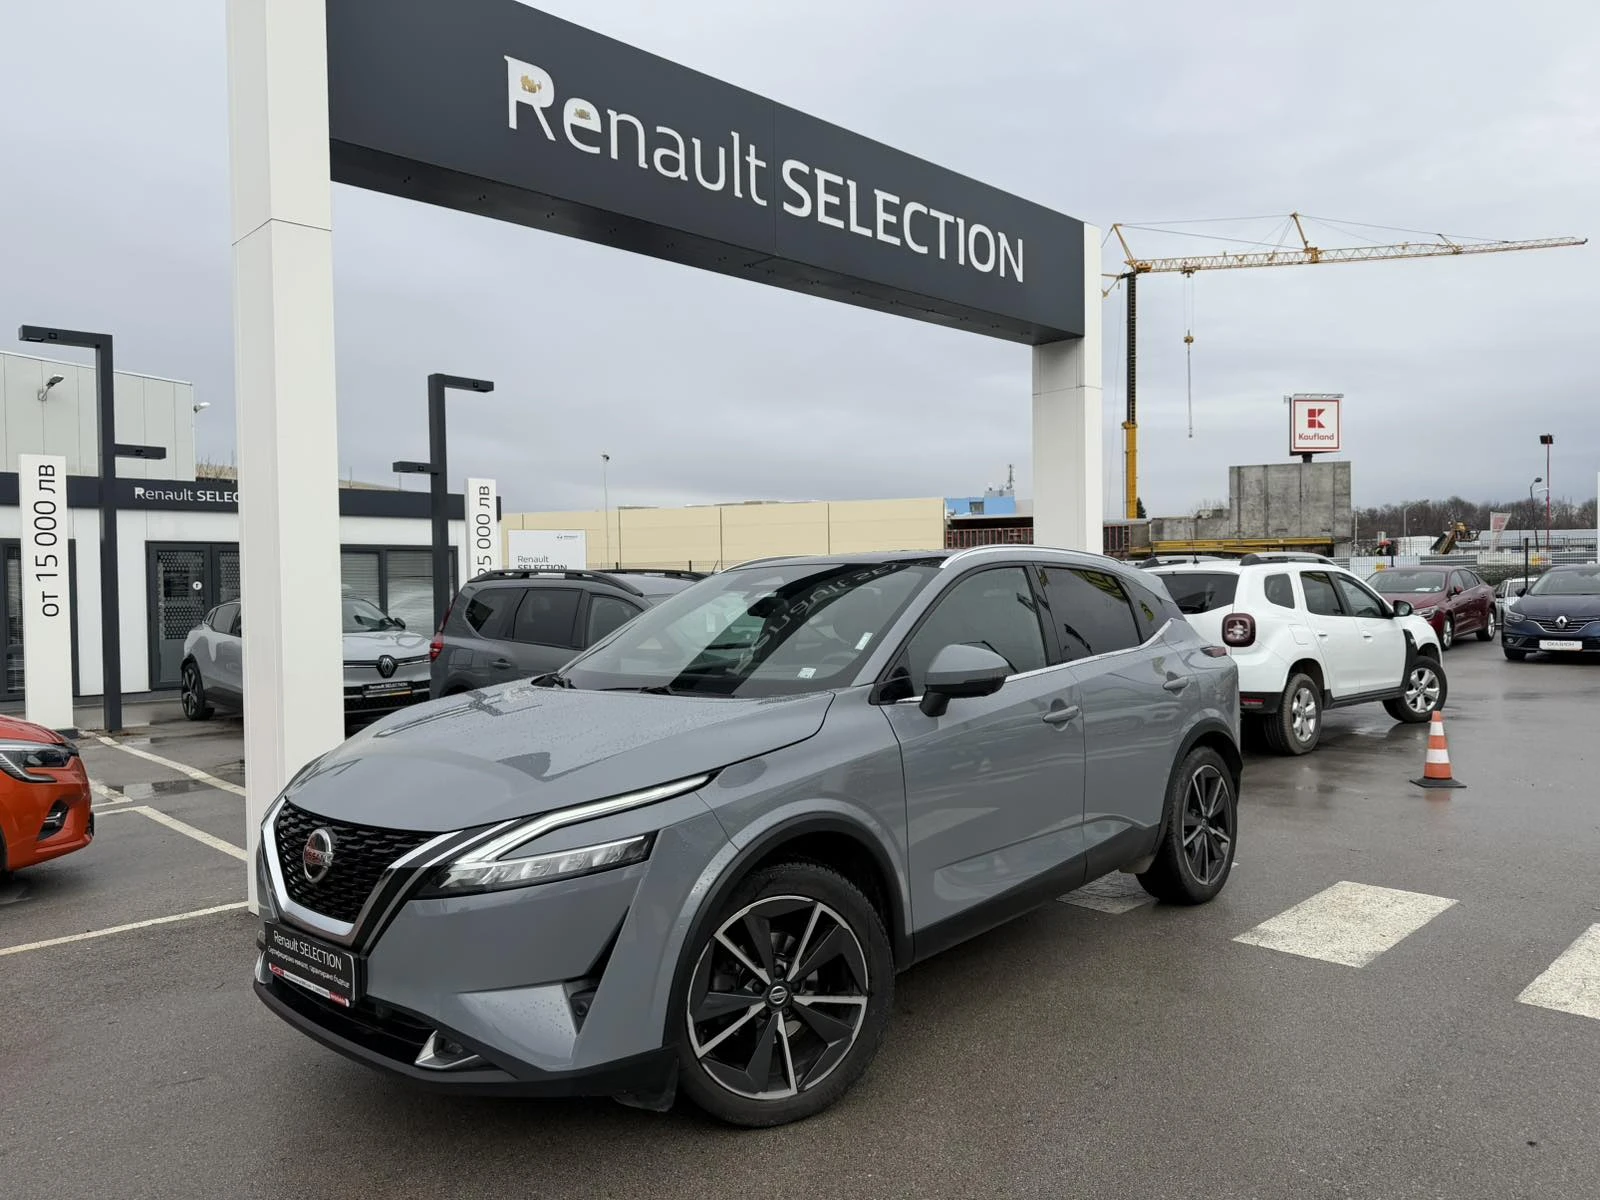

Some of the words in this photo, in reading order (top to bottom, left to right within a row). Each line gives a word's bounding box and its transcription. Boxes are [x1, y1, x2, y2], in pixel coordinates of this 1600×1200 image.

[504, 55, 768, 207] Renault
[782, 159, 1024, 283] SELECTION
[1298, 433, 1334, 441] Kaufland
[134, 487, 194, 501] Renault
[33, 501, 58, 546] 000
[476, 513, 491, 549] 000
[35, 555, 58, 582] 15
[517, 555, 549, 563] Renault
[273, 930, 299, 953] Renault
[299, 941, 342, 971] SELECTION
